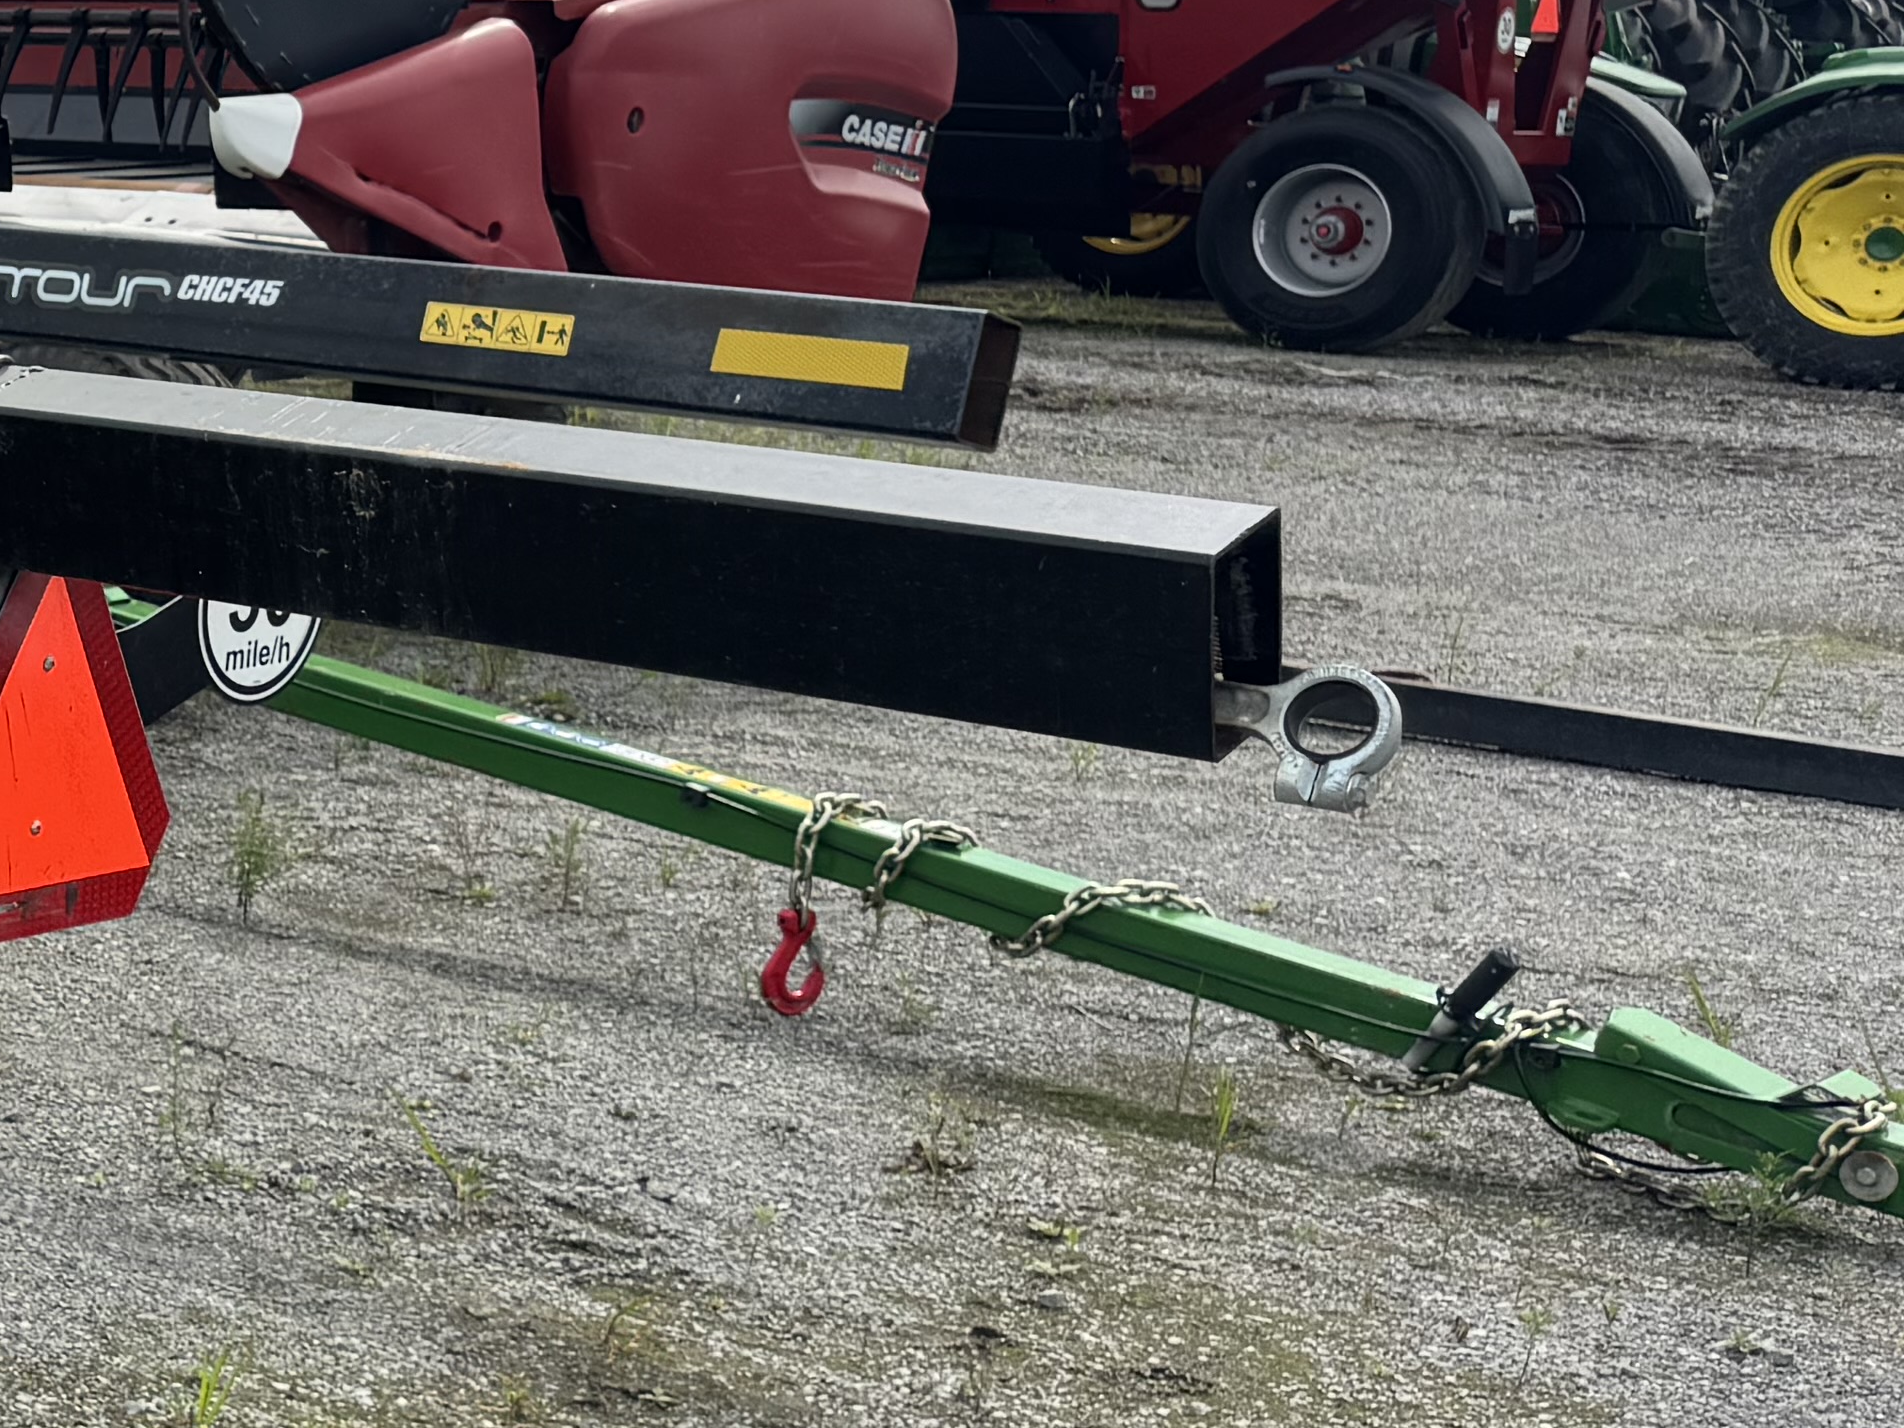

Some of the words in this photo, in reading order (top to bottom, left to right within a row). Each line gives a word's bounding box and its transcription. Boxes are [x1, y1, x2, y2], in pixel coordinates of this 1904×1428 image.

[841, 114, 905, 153] CASE
[176, 274, 286, 307] CHCF45
[224, 635, 290, 672] mile/h
